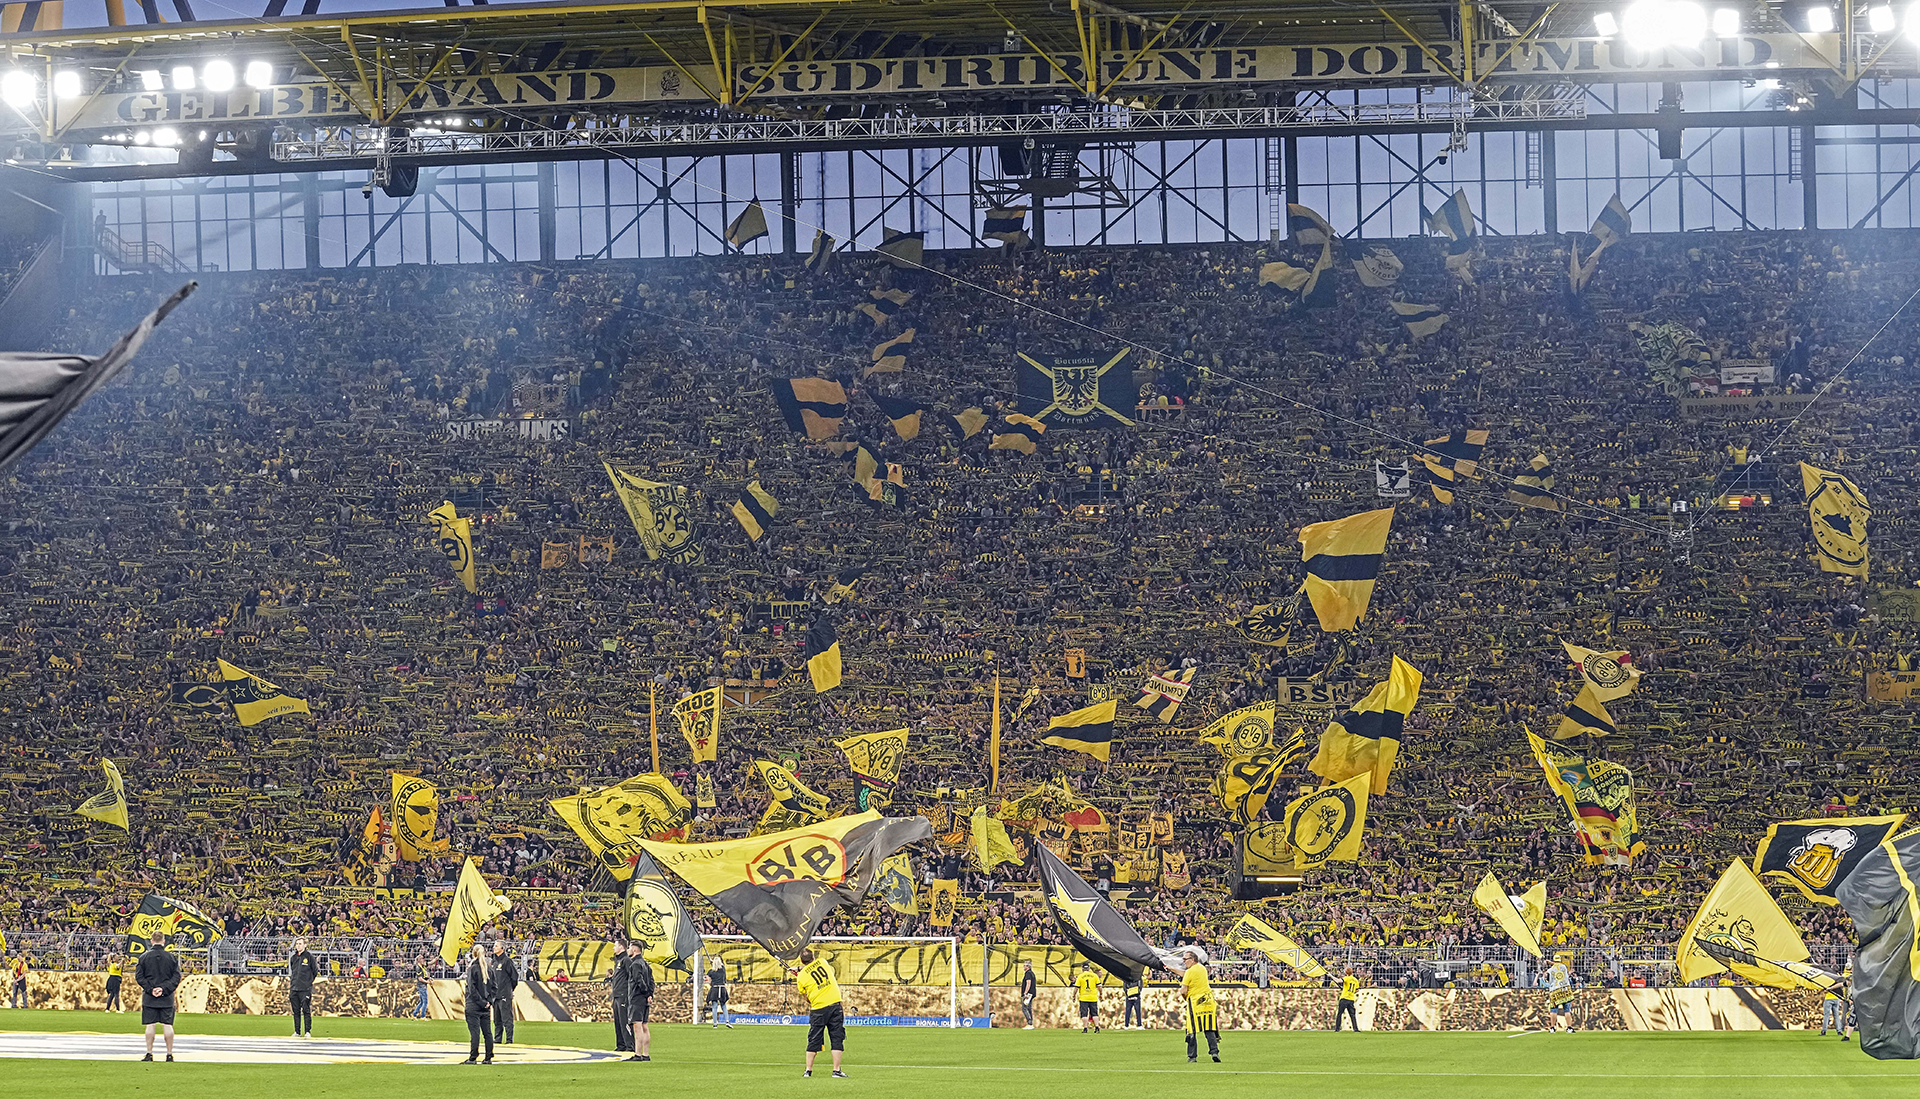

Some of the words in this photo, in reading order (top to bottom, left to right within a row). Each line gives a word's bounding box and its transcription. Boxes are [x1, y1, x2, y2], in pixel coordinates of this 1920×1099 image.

[738, 49, 1257, 94] SÜDTRIBÜNE
[117, 85, 350, 122] GELBE
[396, 72, 616, 110] WAND
[1054, 357, 1095, 365] Borussia
[1054, 411, 1100, 424] Dortmund
[519, 419, 569, 440] JUNGS
[655, 507, 689, 533] BVB
[1589, 764, 1601, 775] 19
[768, 770, 787, 785] BVB
[141, 918, 163, 930] BVB
[810, 965, 829, 986] 09
[1085, 979, 1090, 990] 1
[1347, 982, 1356, 993] 11
[843, 1016, 893, 1026] nanderda
[915, 1019, 941, 1027] SIGNAL
